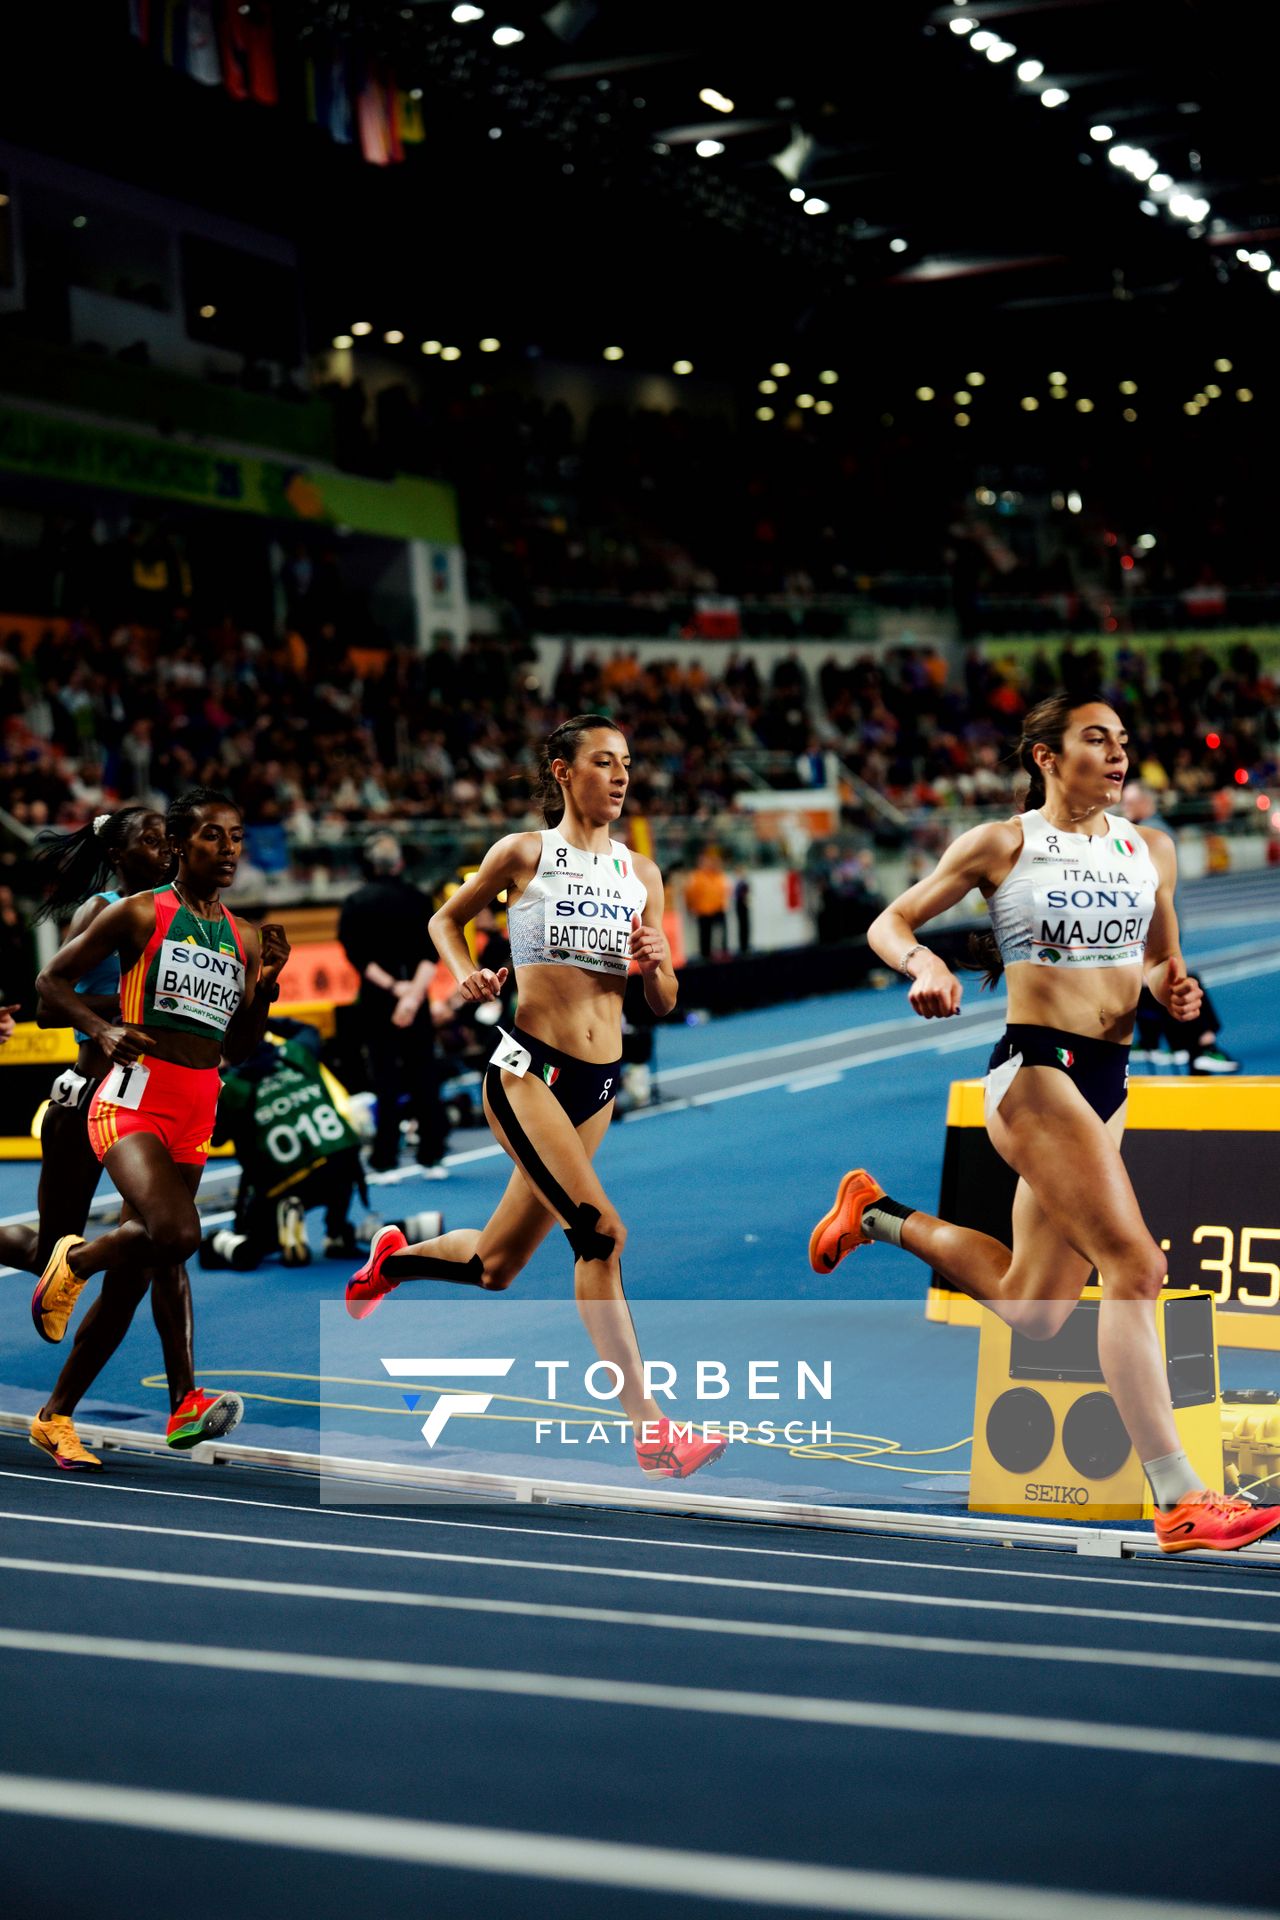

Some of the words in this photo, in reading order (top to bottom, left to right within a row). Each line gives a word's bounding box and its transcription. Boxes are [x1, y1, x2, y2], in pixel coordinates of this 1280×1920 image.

[1063, 869, 1130, 885] ITALIA
[567, 883, 622, 899] ITALIA
[1047, 889, 1142, 909] SONY
[555, 900, 636, 922] SONY
[1041, 918, 1143, 945] MAJORI
[171, 947, 241, 982] SONY
[162, 969, 241, 1013] BAWEKE
[117, 1066, 134, 1099] 1
[266, 1103, 345, 1163] 018
[1024, 1483, 1090, 1506] SEIKO
